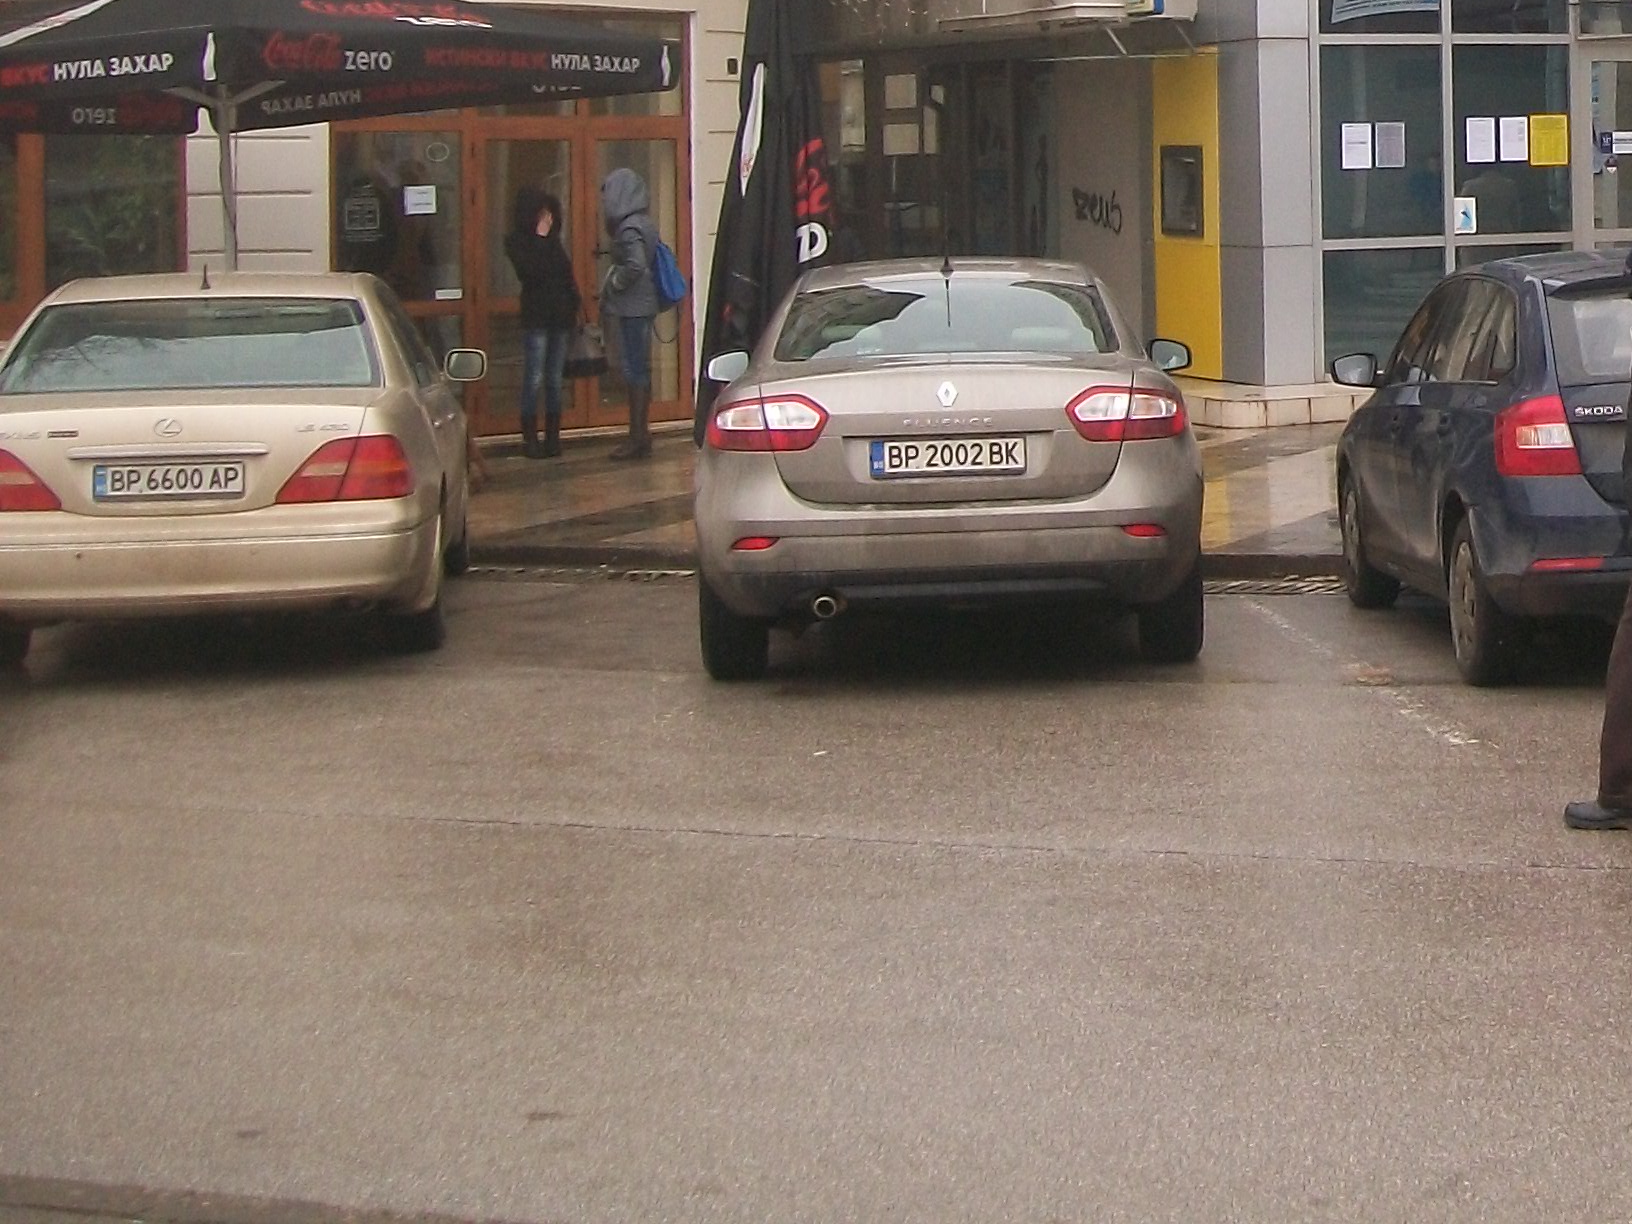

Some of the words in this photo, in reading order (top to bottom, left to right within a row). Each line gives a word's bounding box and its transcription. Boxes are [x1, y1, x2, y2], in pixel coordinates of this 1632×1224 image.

[53, 59, 106, 81] НУЛА
[109, 53, 174, 76] ЗАХАР
[344, 50, 393, 71] zero
[551, 54, 591, 72] НУЛА
[593, 55, 641, 74] ЗАХАР
[925, 442, 984, 467] 2002
[146, 467, 203, 491] 6600
